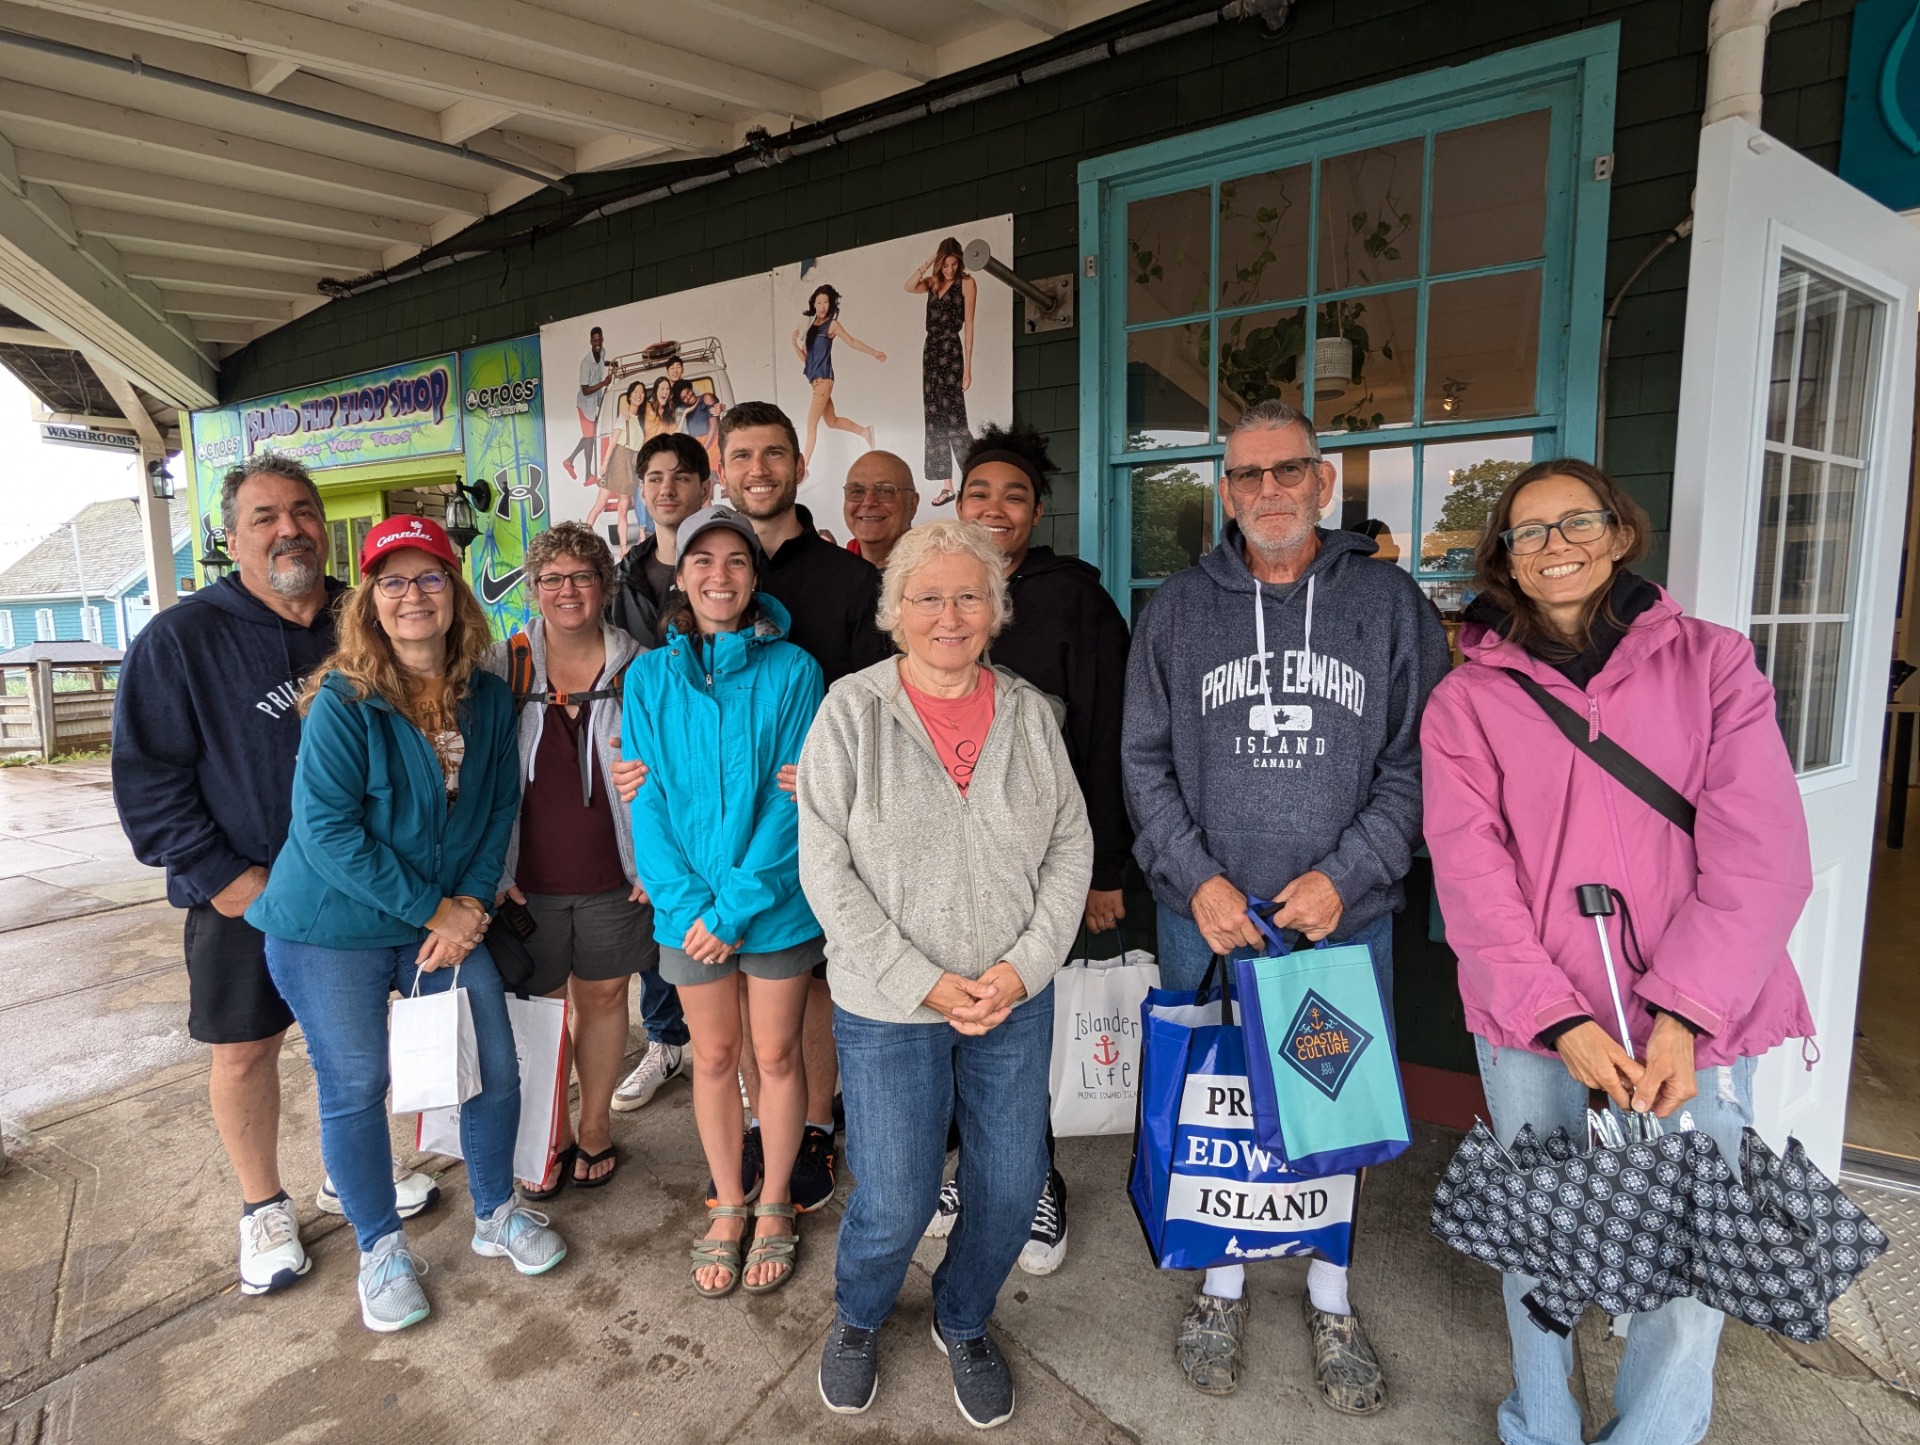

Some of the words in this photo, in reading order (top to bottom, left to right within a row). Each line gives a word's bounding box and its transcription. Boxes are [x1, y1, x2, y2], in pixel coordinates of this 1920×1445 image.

[479, 379, 534, 406] crocs
[246, 404, 301, 455] ISLAND
[301, 396, 338, 432] FLIP
[338, 386, 389, 426] FLOP
[389, 368, 448, 425] SHOP
[47, 426, 136, 446] WASHROOMS
[206, 436, 239, 458] crocs
[376, 529, 432, 548] Canada
[1202, 651, 1275, 716] PRINCE
[1282, 650, 1366, 718] EDWARD
[1235, 736, 1326, 756] ISLAND
[1253, 758, 1303, 769] CANADA
[1074, 1008, 1139, 1041] Islander
[1295, 1030, 1349, 1049] COASTAL
[1297, 1041, 1351, 1061] CULTURE
[1081, 1061, 1131, 1089] Life
[1196, 1188, 1328, 1222] ISLAND
